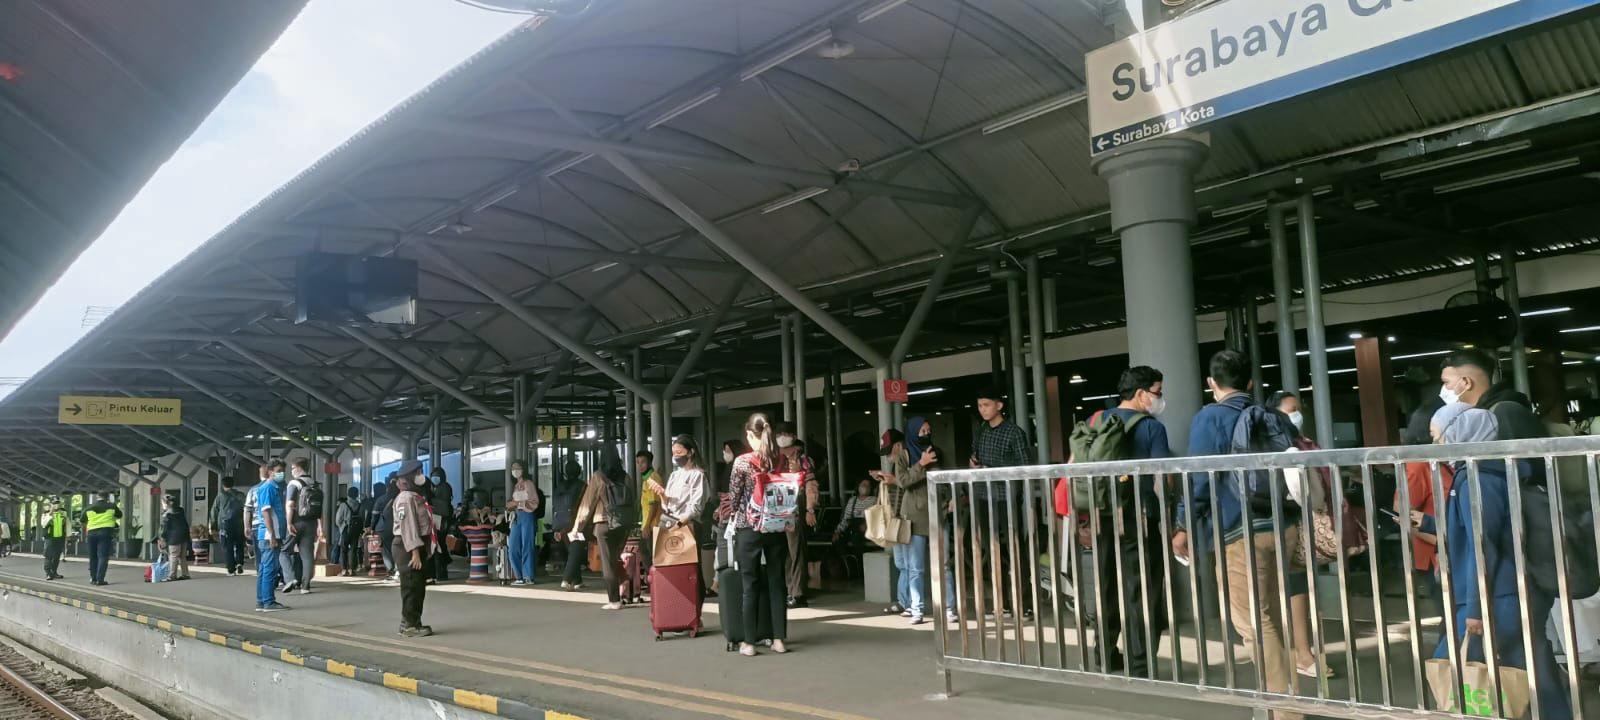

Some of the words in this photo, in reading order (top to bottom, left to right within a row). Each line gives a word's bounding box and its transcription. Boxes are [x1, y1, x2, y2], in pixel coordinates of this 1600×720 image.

[1111, 3, 1328, 102] Surabaya
[1112, 117, 1177, 146] Surabaya
[1180, 106, 1215, 125] Kota
[109, 403, 137, 413] Pintu
[140, 404, 174, 413] Keluar
